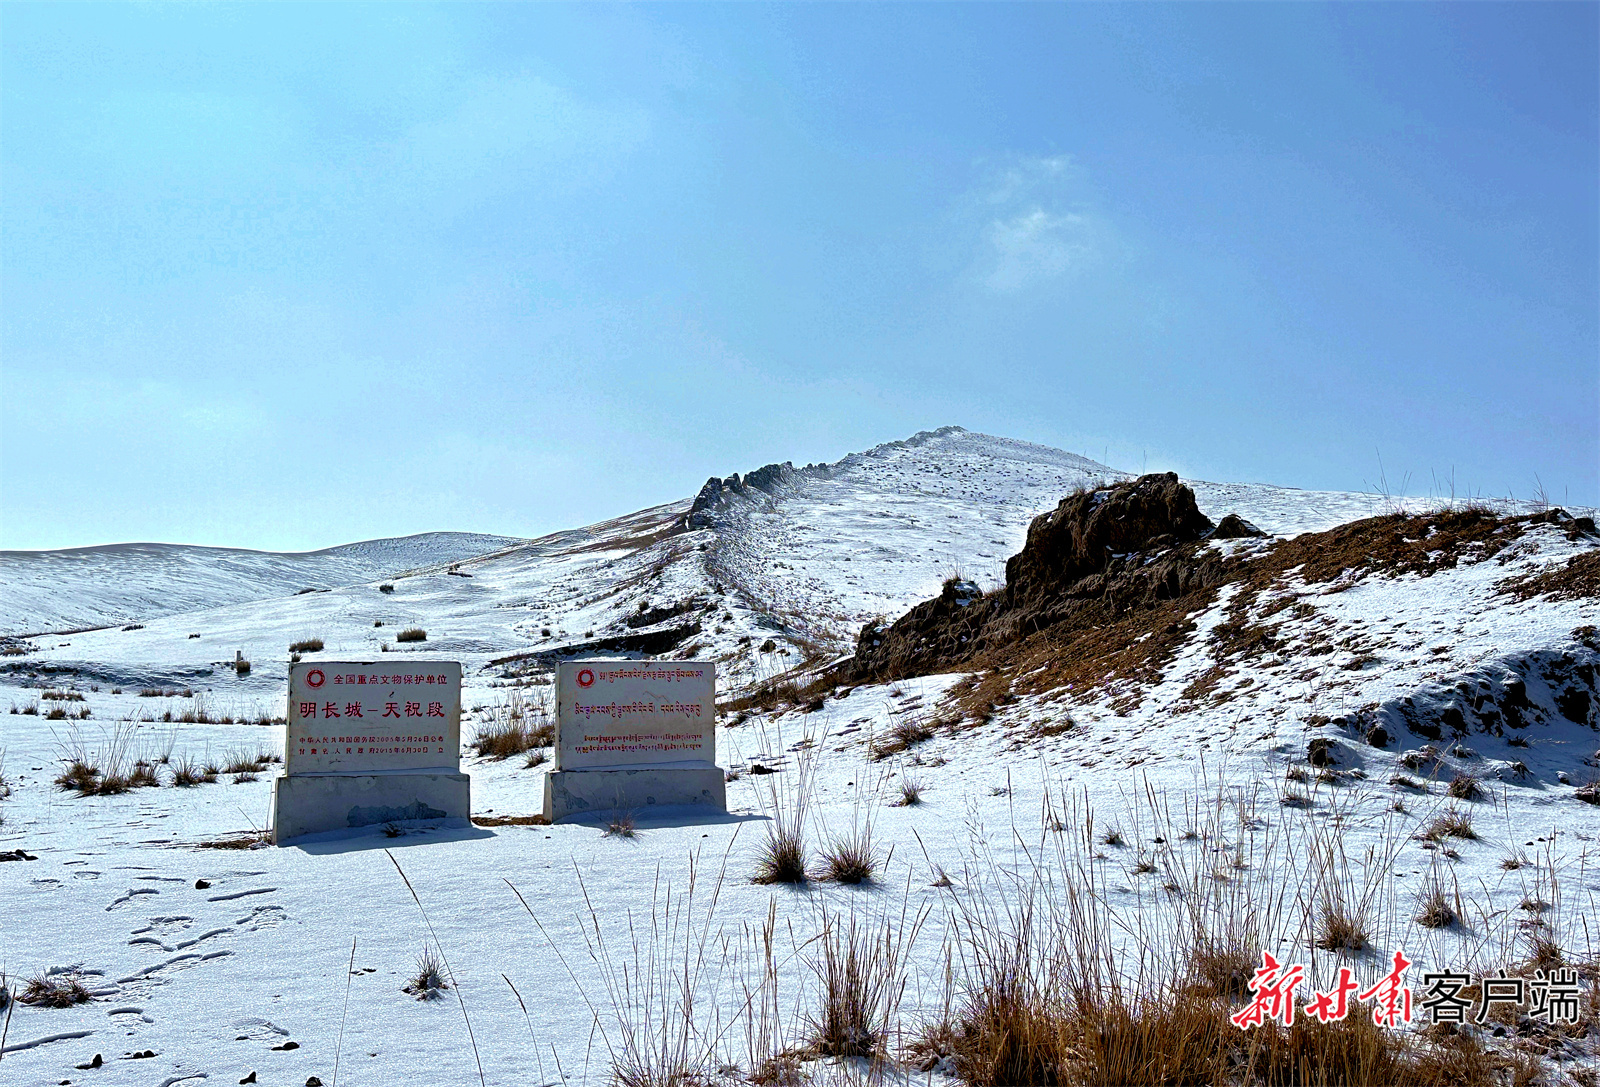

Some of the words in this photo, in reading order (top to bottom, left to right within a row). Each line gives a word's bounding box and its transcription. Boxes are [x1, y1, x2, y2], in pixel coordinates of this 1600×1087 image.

[333, 674, 448, 685] 全国重点文物保护单位
